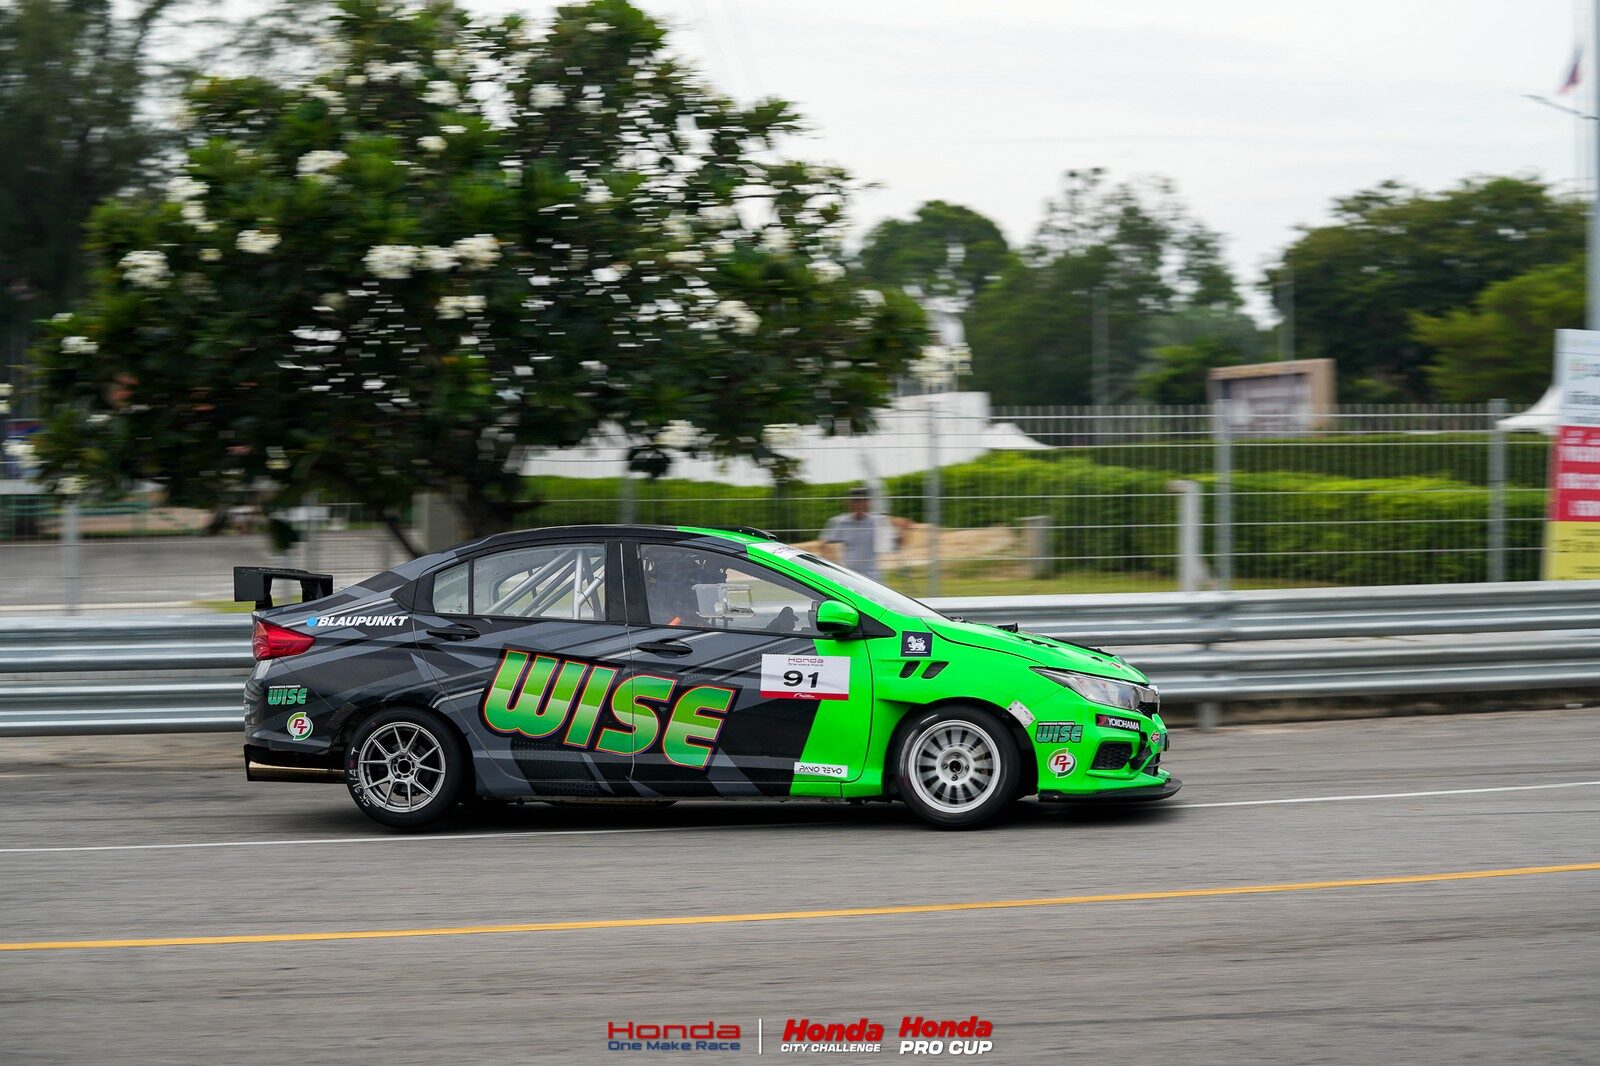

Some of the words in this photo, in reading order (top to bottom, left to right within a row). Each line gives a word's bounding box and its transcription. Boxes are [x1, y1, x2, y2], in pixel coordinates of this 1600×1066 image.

[317, 616, 409, 627] BLAUPUNKT
[783, 670, 819, 688] 91
[267, 688, 308, 705] WISE
[484, 648, 737, 770] WISE
[1107, 717, 1140, 730] YOKOHAMA
[1036, 725, 1082, 742] WISE
